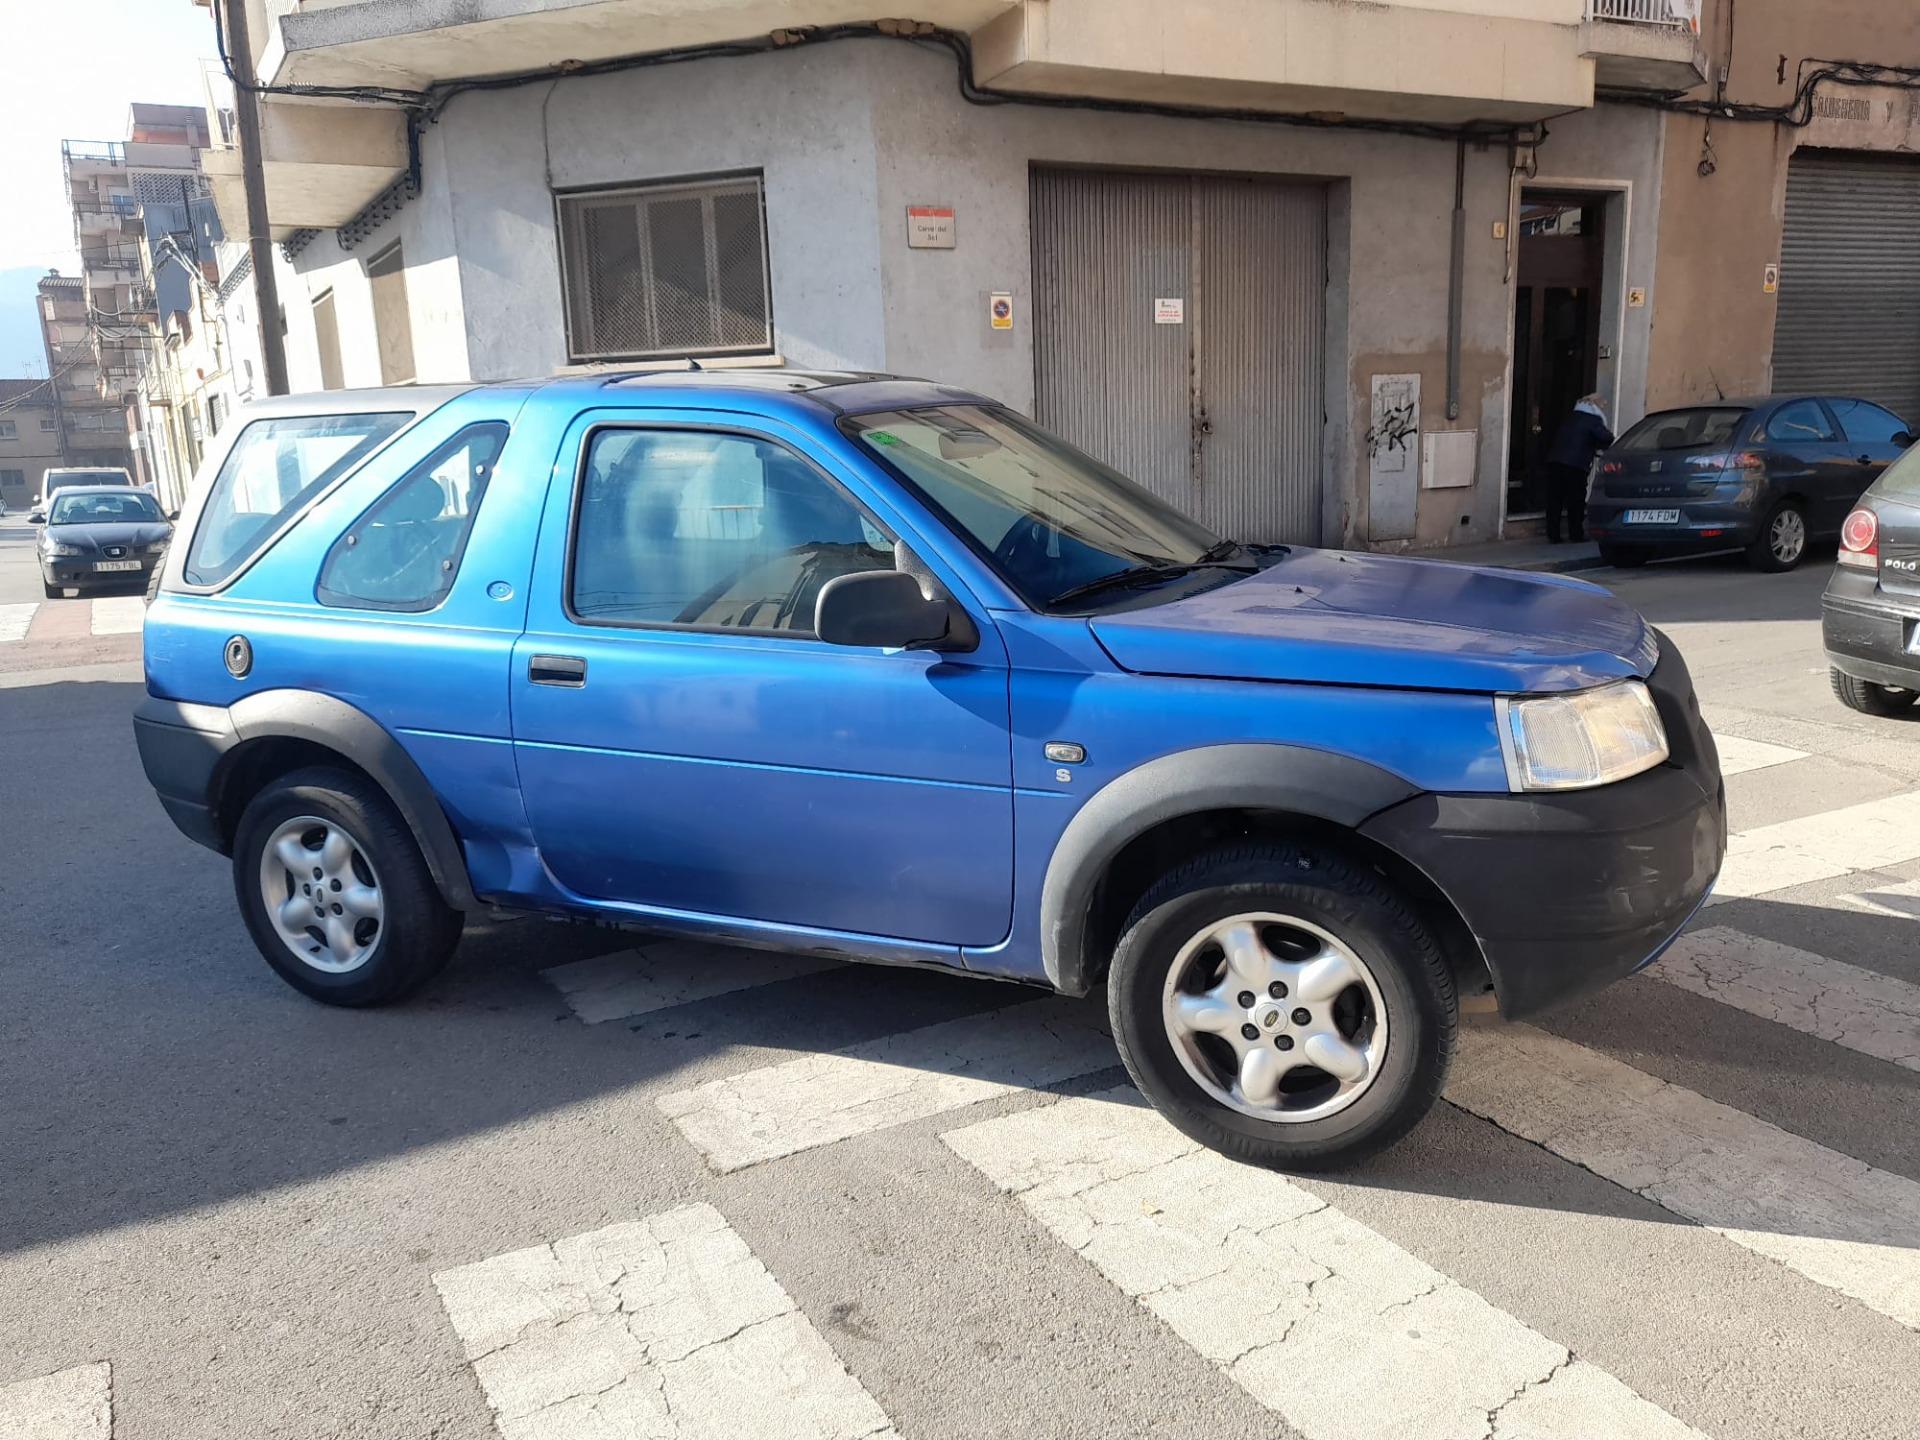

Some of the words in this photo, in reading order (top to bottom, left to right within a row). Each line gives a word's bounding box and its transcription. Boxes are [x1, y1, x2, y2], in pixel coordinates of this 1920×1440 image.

[1632, 511, 1654, 521] 1174
[1657, 511, 1677, 521] FDM
[1885, 559, 1916, 570] POLO
[1056, 768, 1071, 783] S
